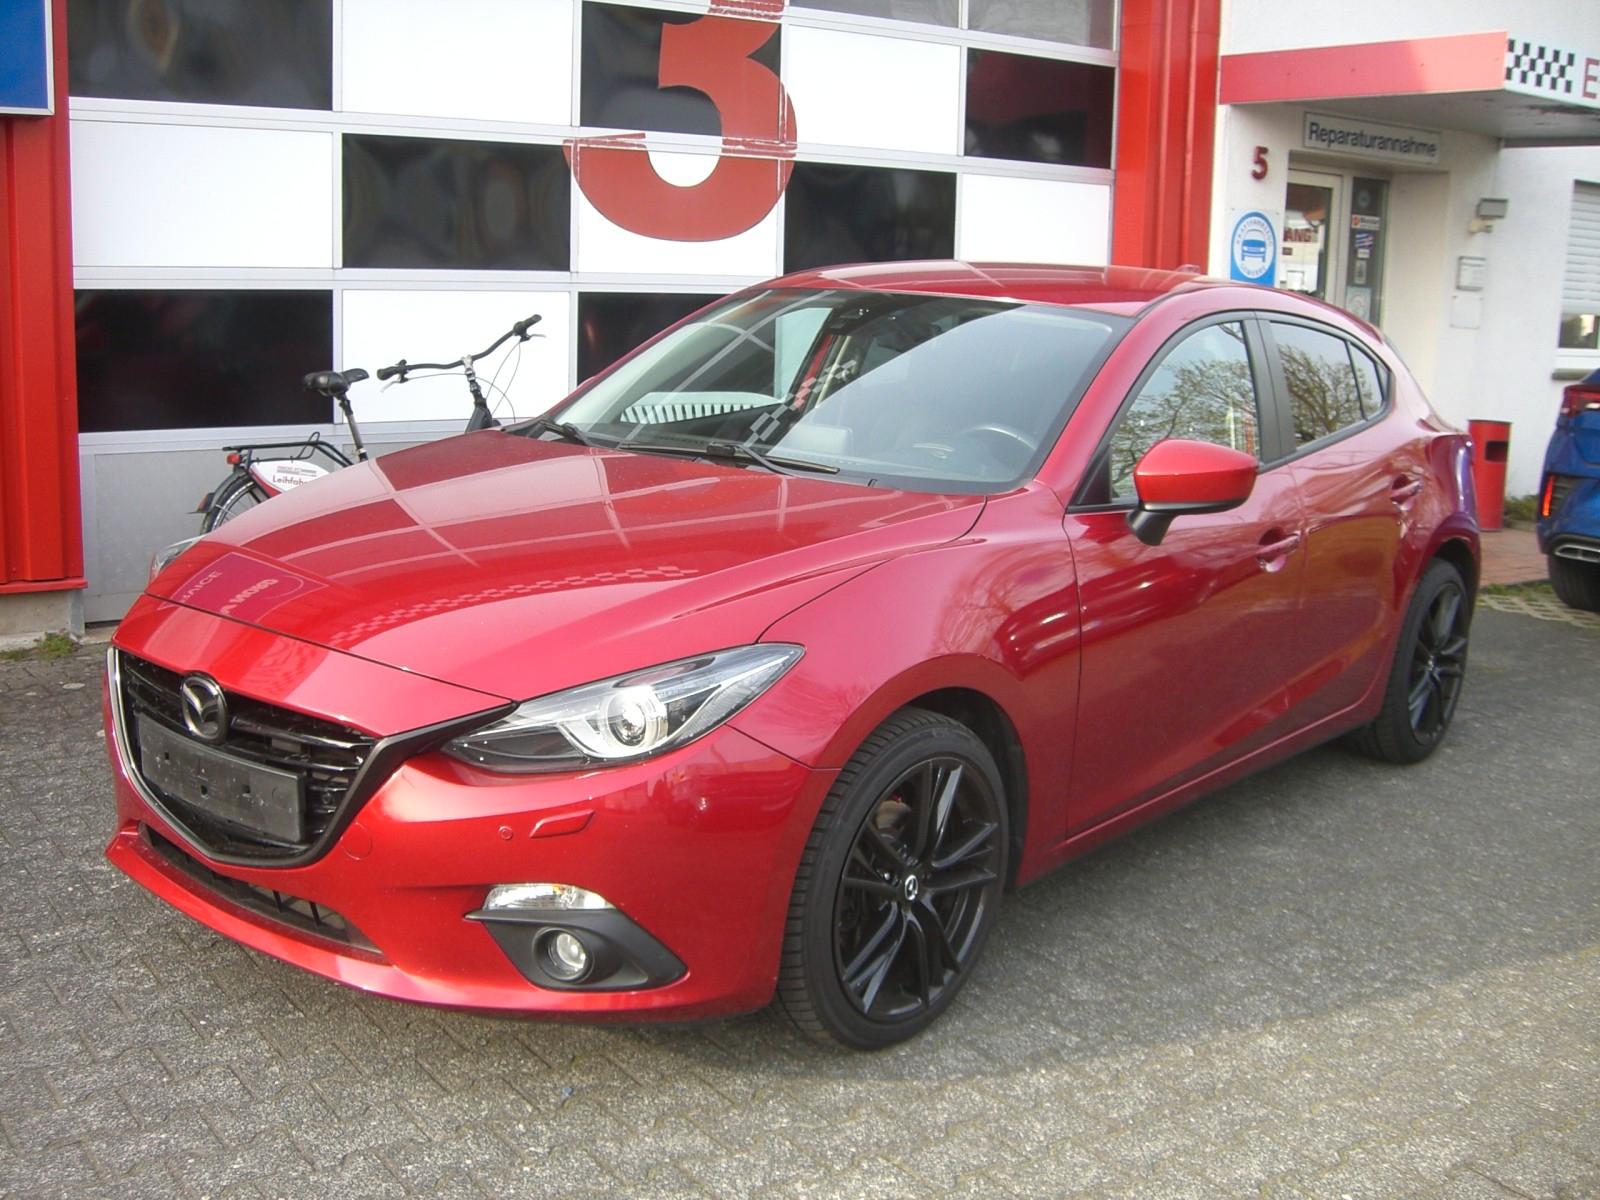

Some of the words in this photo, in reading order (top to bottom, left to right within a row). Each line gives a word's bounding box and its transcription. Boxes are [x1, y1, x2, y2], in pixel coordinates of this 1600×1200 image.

[1582, 57, 1600, 100] E
[563, 0, 797, 242] 3
[1308, 121, 1438, 158] Reparaturannahme
[1251, 145, 1269, 181] 5
[272, 474, 308, 487] Leihfah
